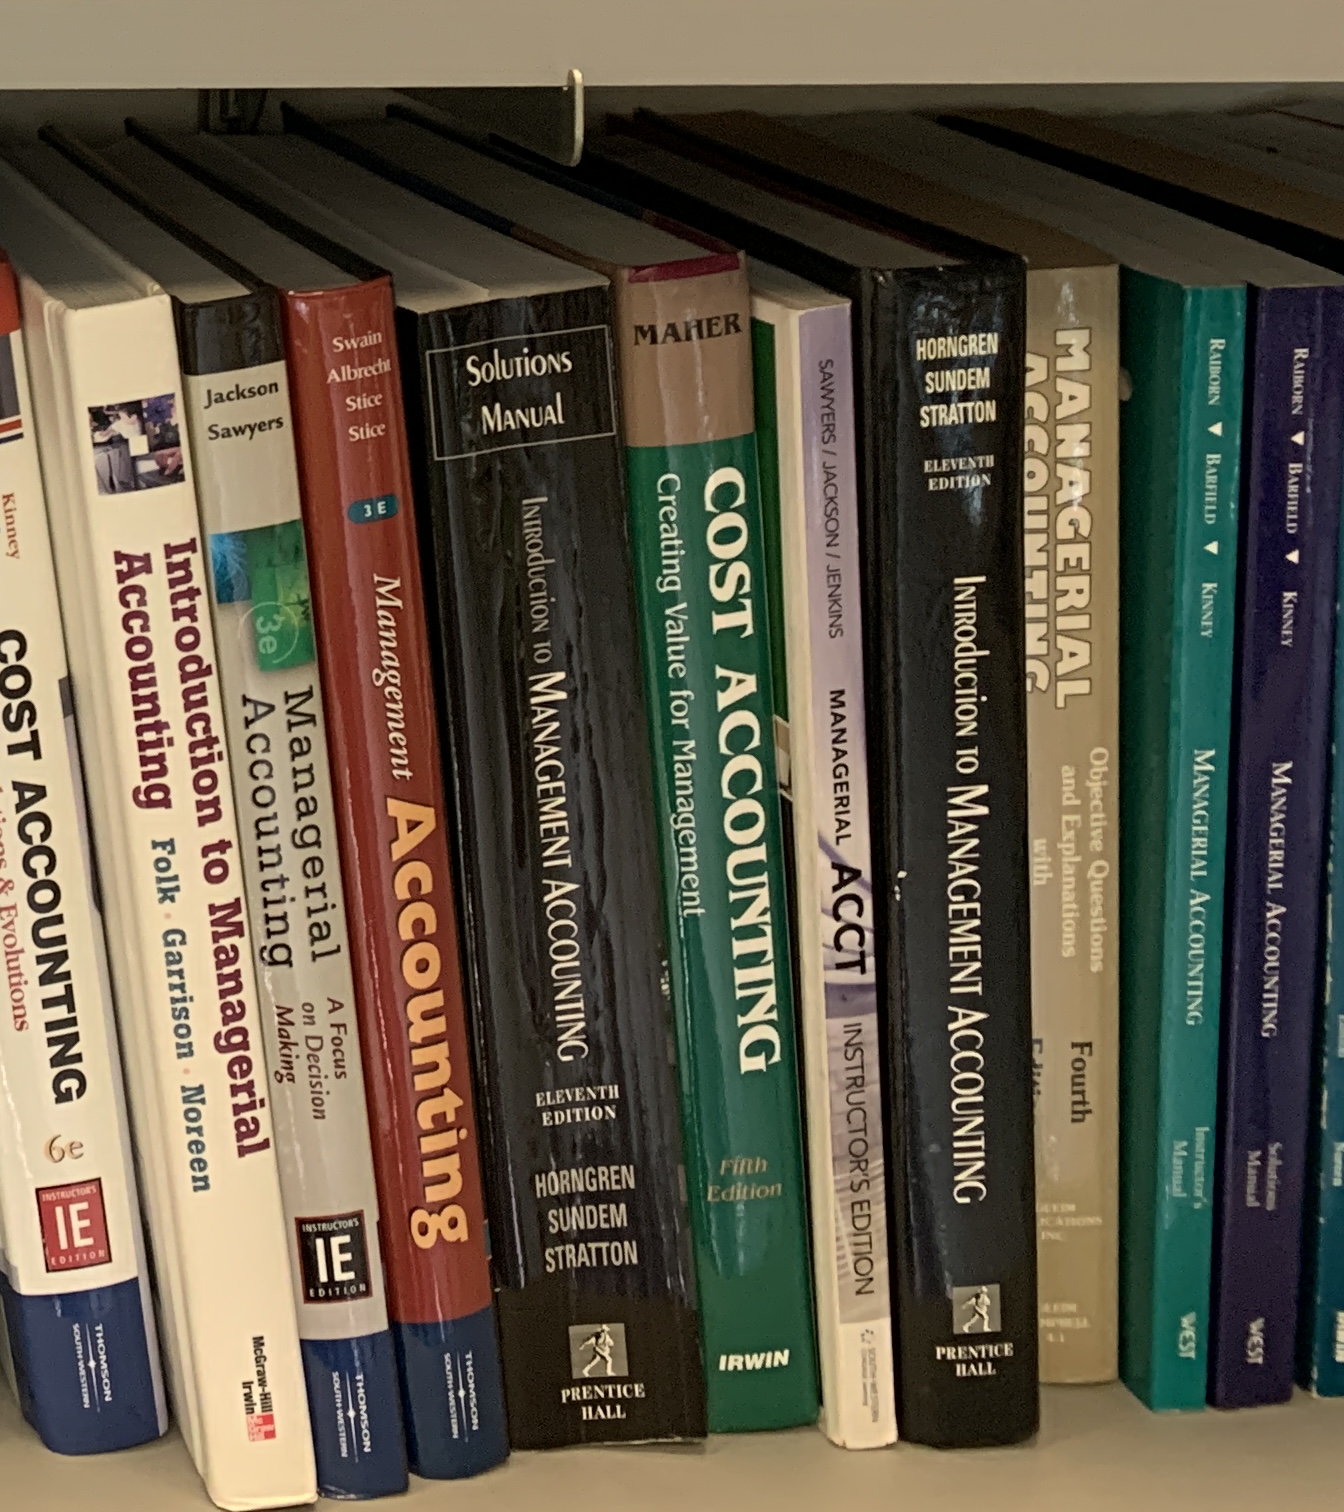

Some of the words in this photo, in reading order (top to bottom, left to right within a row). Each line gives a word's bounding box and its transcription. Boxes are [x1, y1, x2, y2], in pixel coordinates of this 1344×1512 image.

[332, 330, 382, 354] Swain
[632, 313, 742, 346] MAHER
[916, 333, 999, 360] HORNGREN
[327, 355, 391, 383] Albrecht
[925, 369, 990, 394] SUNDEM
[203, 378, 280, 408] Jackson
[207, 413, 283, 443] Sawyers
[919, 400, 997, 428] STRATTON
[703, 467, 757, 639] COST
[715, 665, 783, 1076] ACCOUNTING
[12, 776, 87, 1105] ACCOUNTING
[535, 1166, 635, 1196] HORNGREN
[548, 1206, 628, 1233] SUNDEM
[545, 1241, 638, 1272] STRATTON
[719, 1350, 790, 1370] IRWIN
